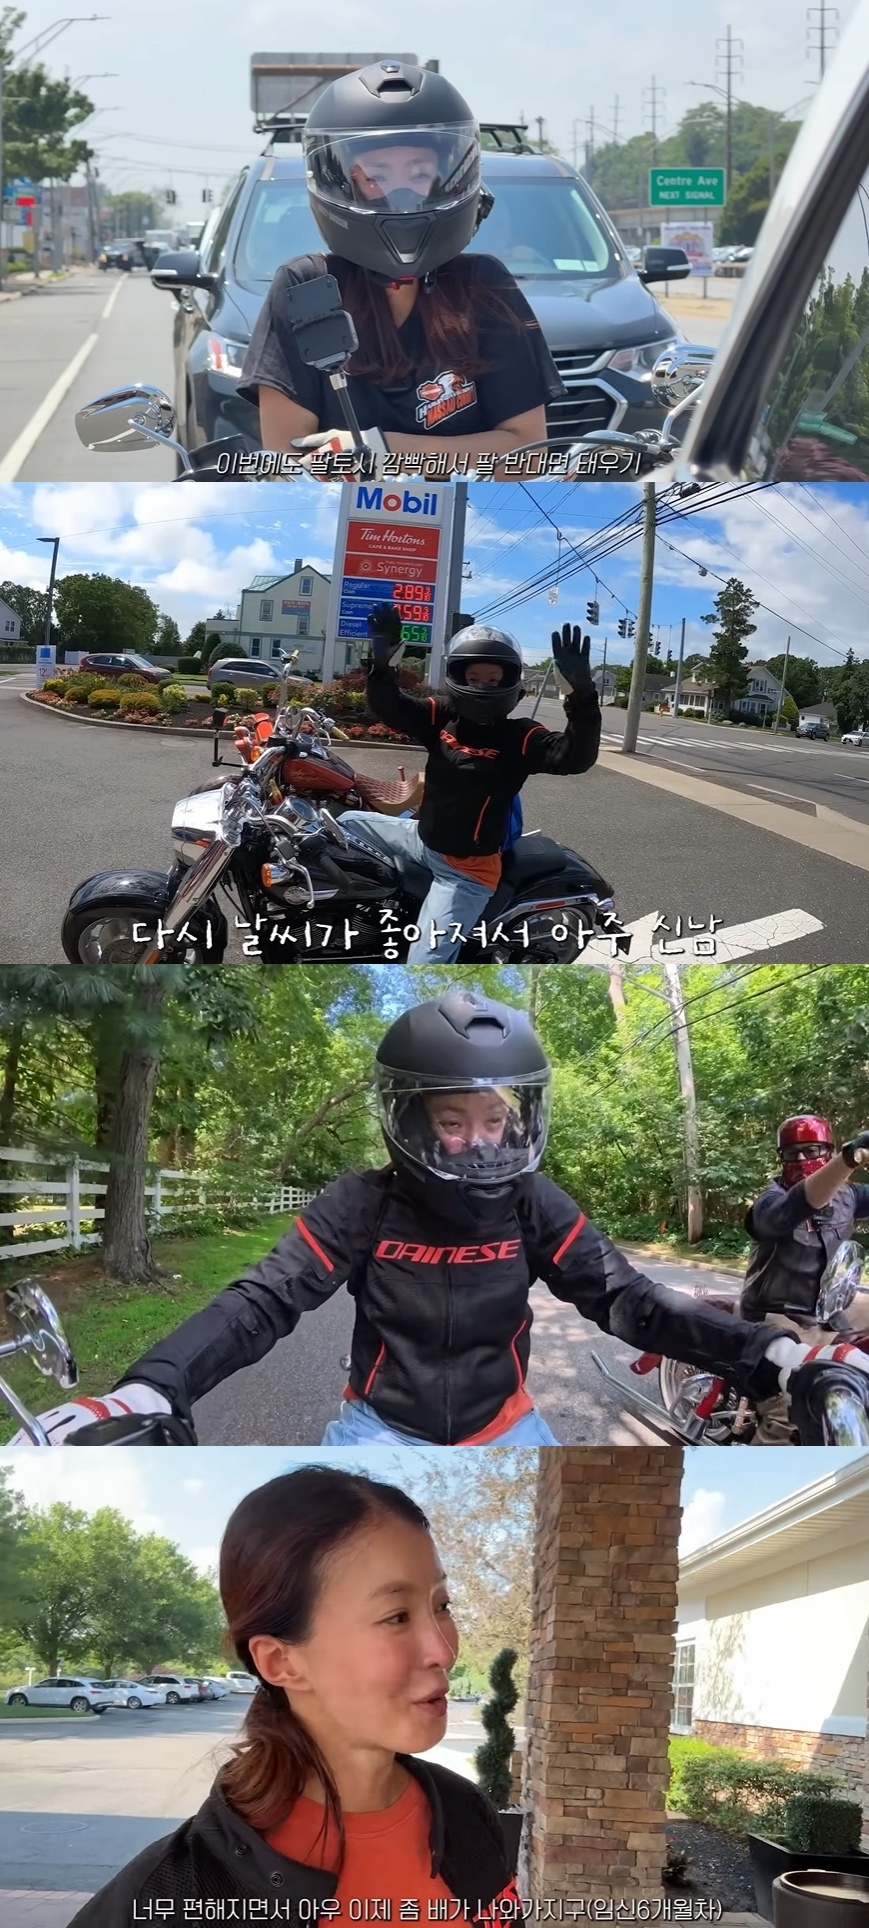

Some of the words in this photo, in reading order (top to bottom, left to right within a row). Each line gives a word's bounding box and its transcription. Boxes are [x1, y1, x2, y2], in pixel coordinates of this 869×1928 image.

[656, 175, 692, 186] Centre
[697, 175, 718, 186] Ave
[658, 191, 680, 199] NEXT
[685, 191, 715, 199] SIGNAL
[356, 486, 437, 516] Mobil
[360, 528, 380, 542] Tim
[382, 529, 426, 546] Hortons
[377, 562, 423, 578] Synergy
[343, 581, 371, 590] Regular
[341, 601, 374, 610] Supreme
[341, 620, 361, 628] Diesel
[340, 629, 369, 637] Efficient
[375, 1238, 522, 1265] DAINESE
